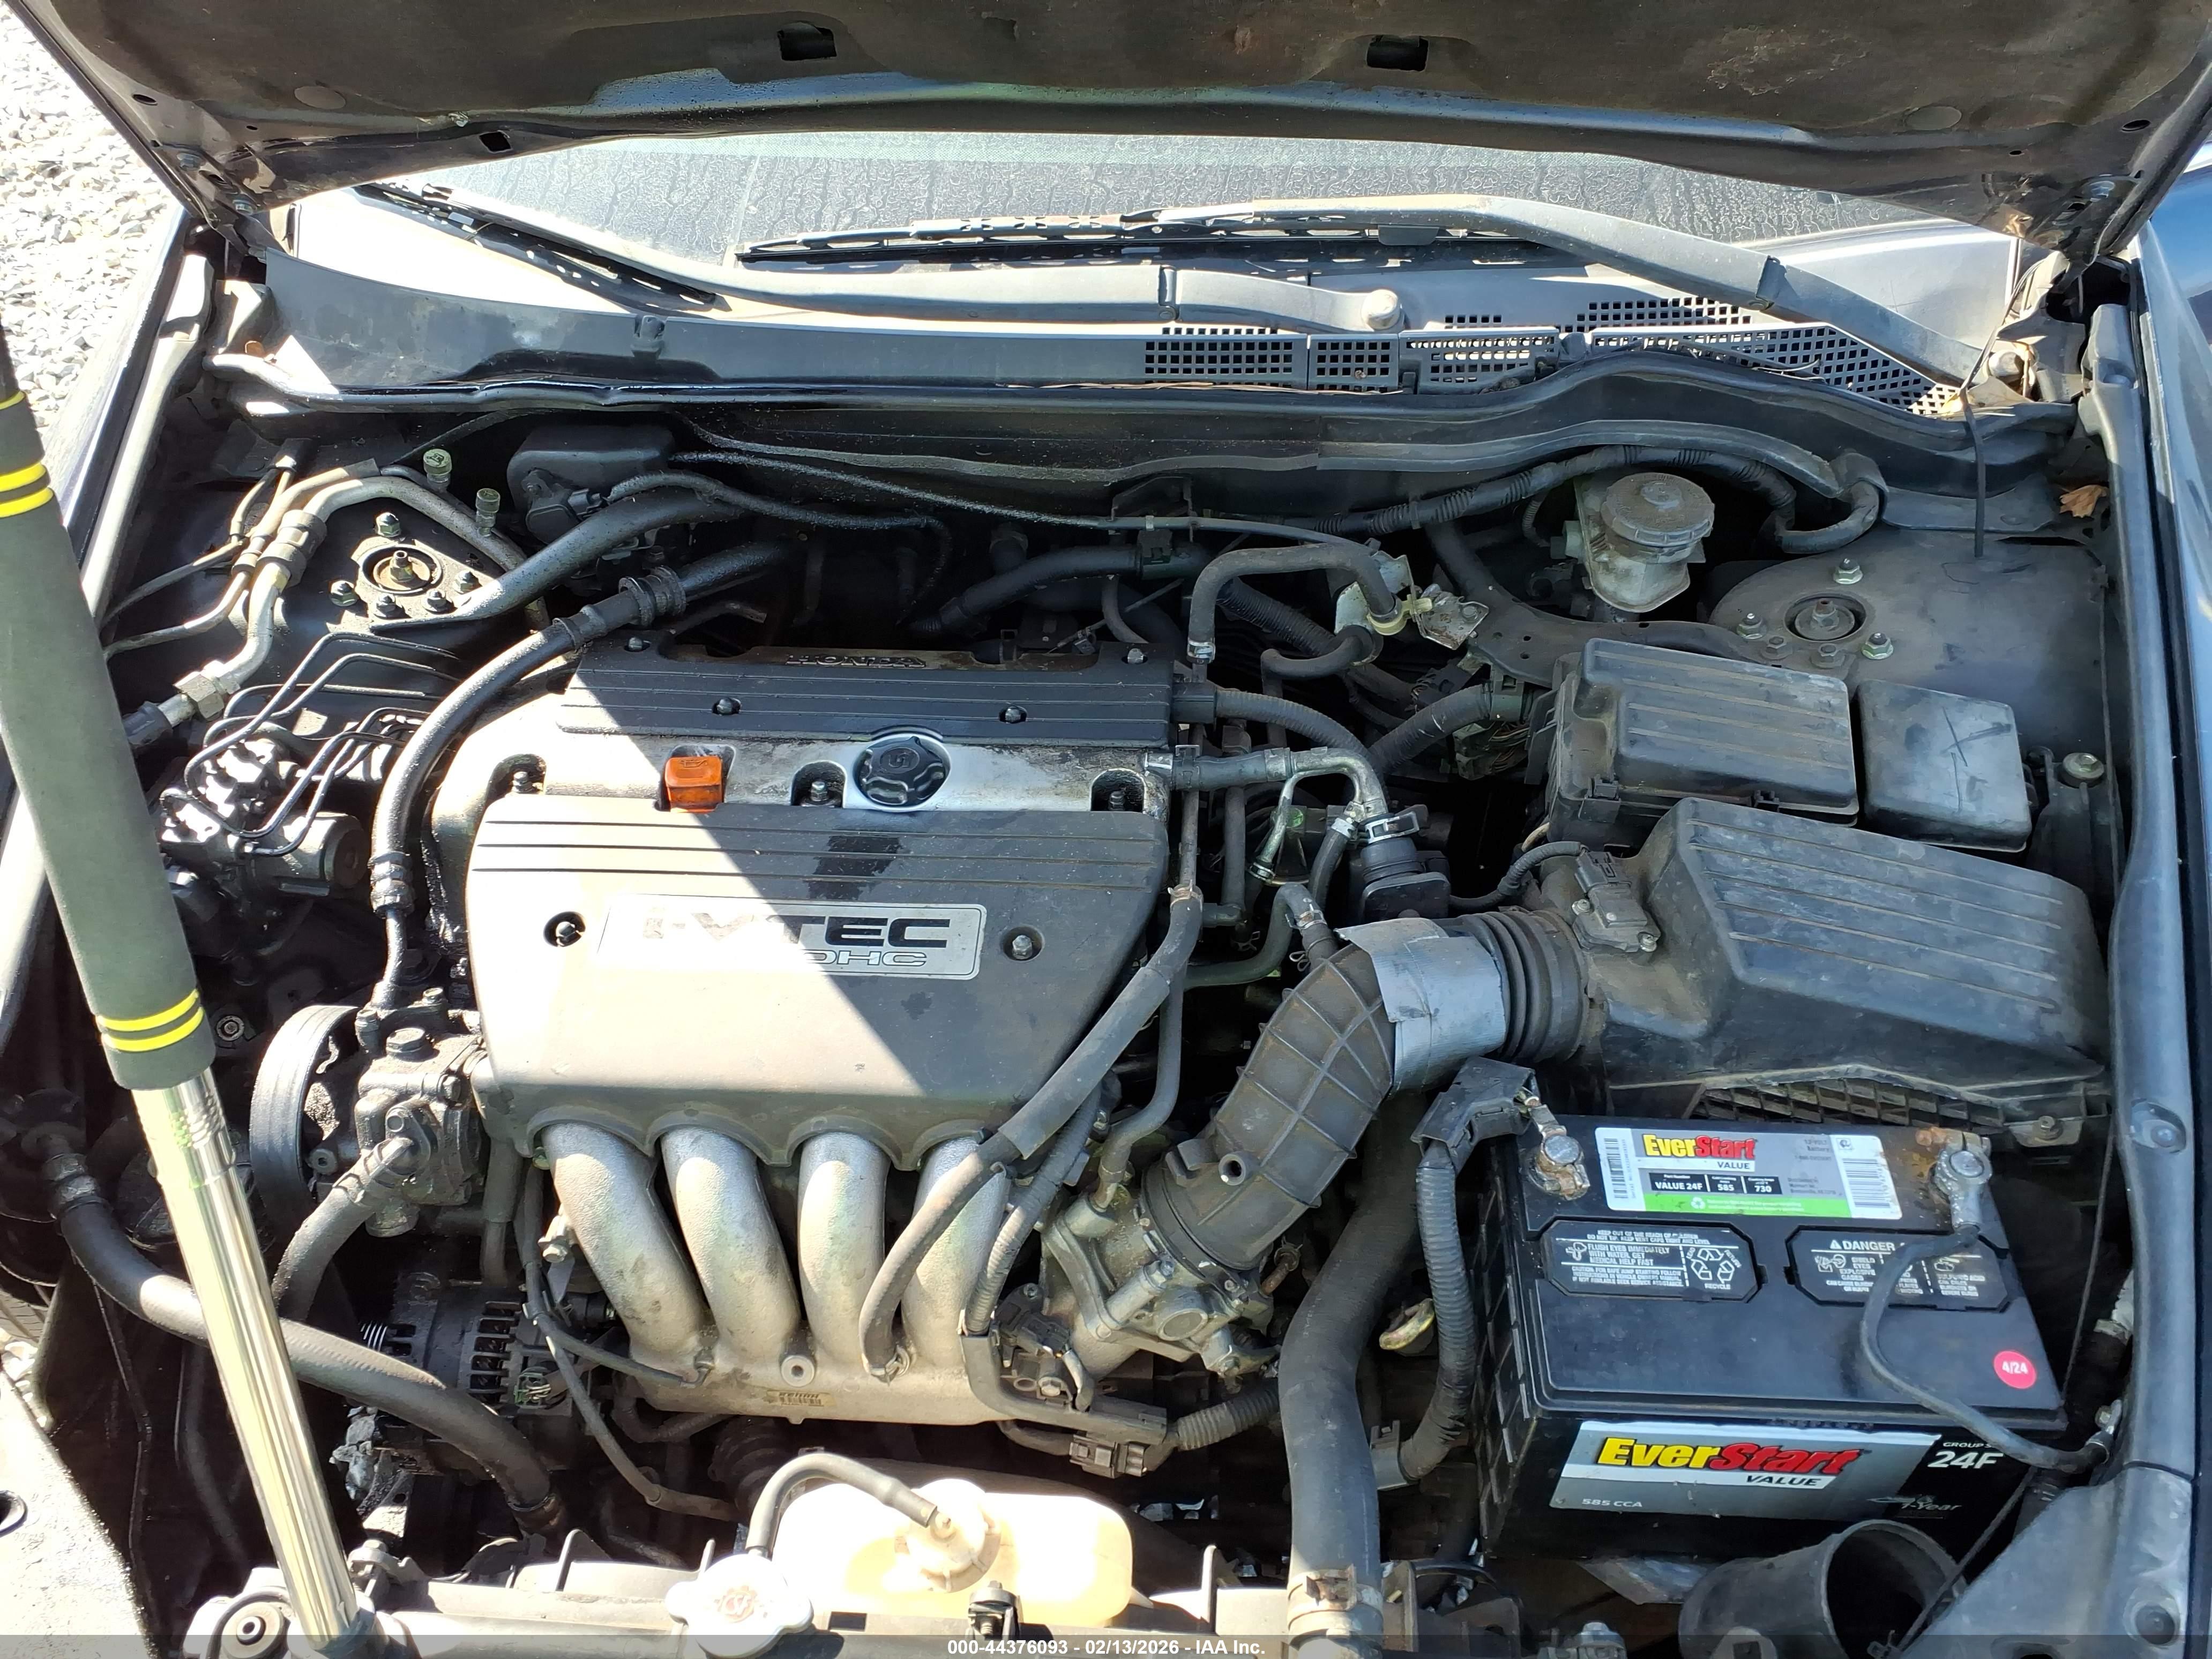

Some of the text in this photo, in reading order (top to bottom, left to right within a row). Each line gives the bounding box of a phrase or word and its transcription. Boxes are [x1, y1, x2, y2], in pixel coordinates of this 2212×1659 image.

[1642, 1133, 1755, 1160] EverStart
[1717, 1161, 1750, 1170] VALUE
[1655, 1182, 1685, 1190] VALUE
[1842, 1240, 1896, 1251] DANGER
[2001, 1361, 2029, 1374] 4/24
[1596, 1437, 1860, 1475] EverStart
[1927, 1451, 2004, 1469] 24F
[1746, 1475, 1822, 1486] VALUE
[1581, 1498, 1611, 1506] 585
